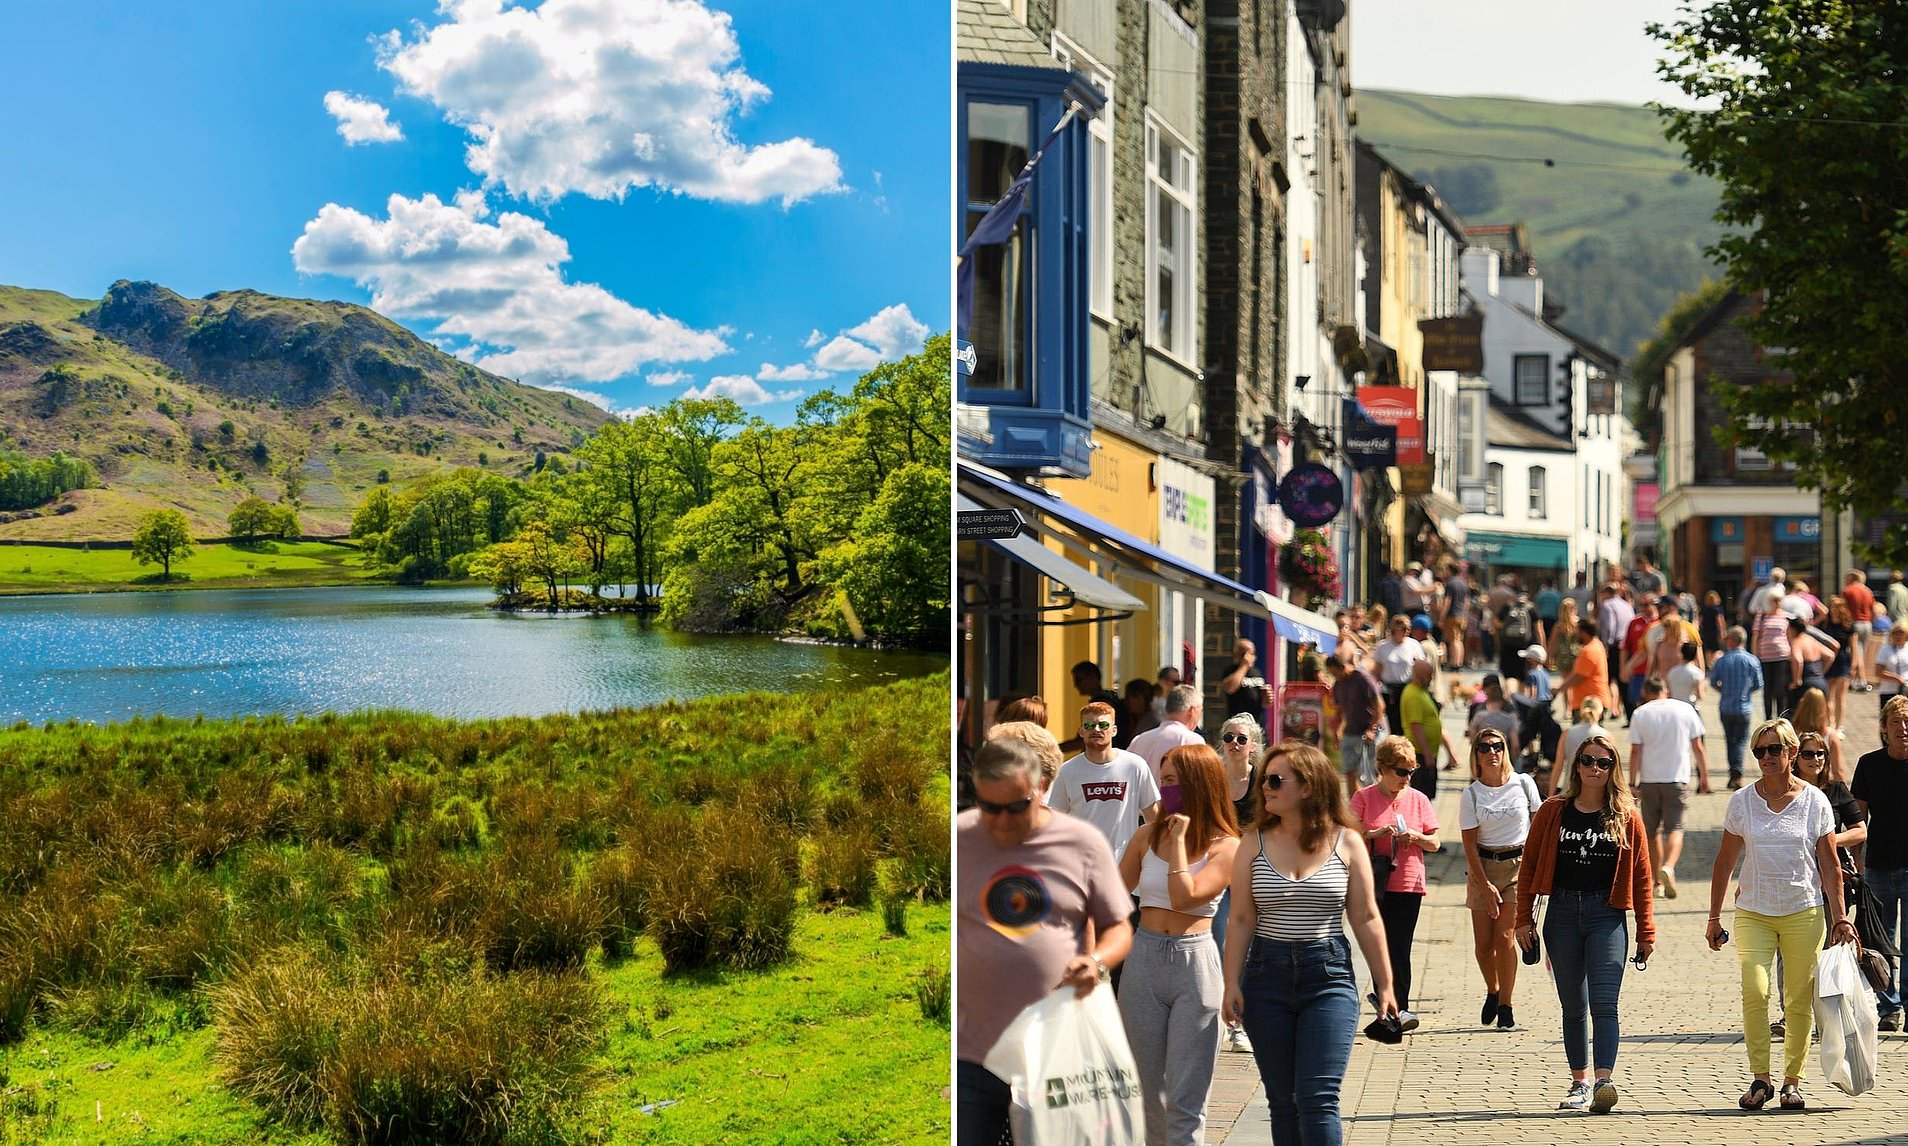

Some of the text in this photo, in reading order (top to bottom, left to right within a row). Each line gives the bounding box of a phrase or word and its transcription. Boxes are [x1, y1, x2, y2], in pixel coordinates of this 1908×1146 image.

[962, 515, 983, 524] SQUARE
[984, 514, 1009, 522] SHOPPING
[967, 526, 986, 535] STREET
[987, 526, 1013, 534] SHOPPING
